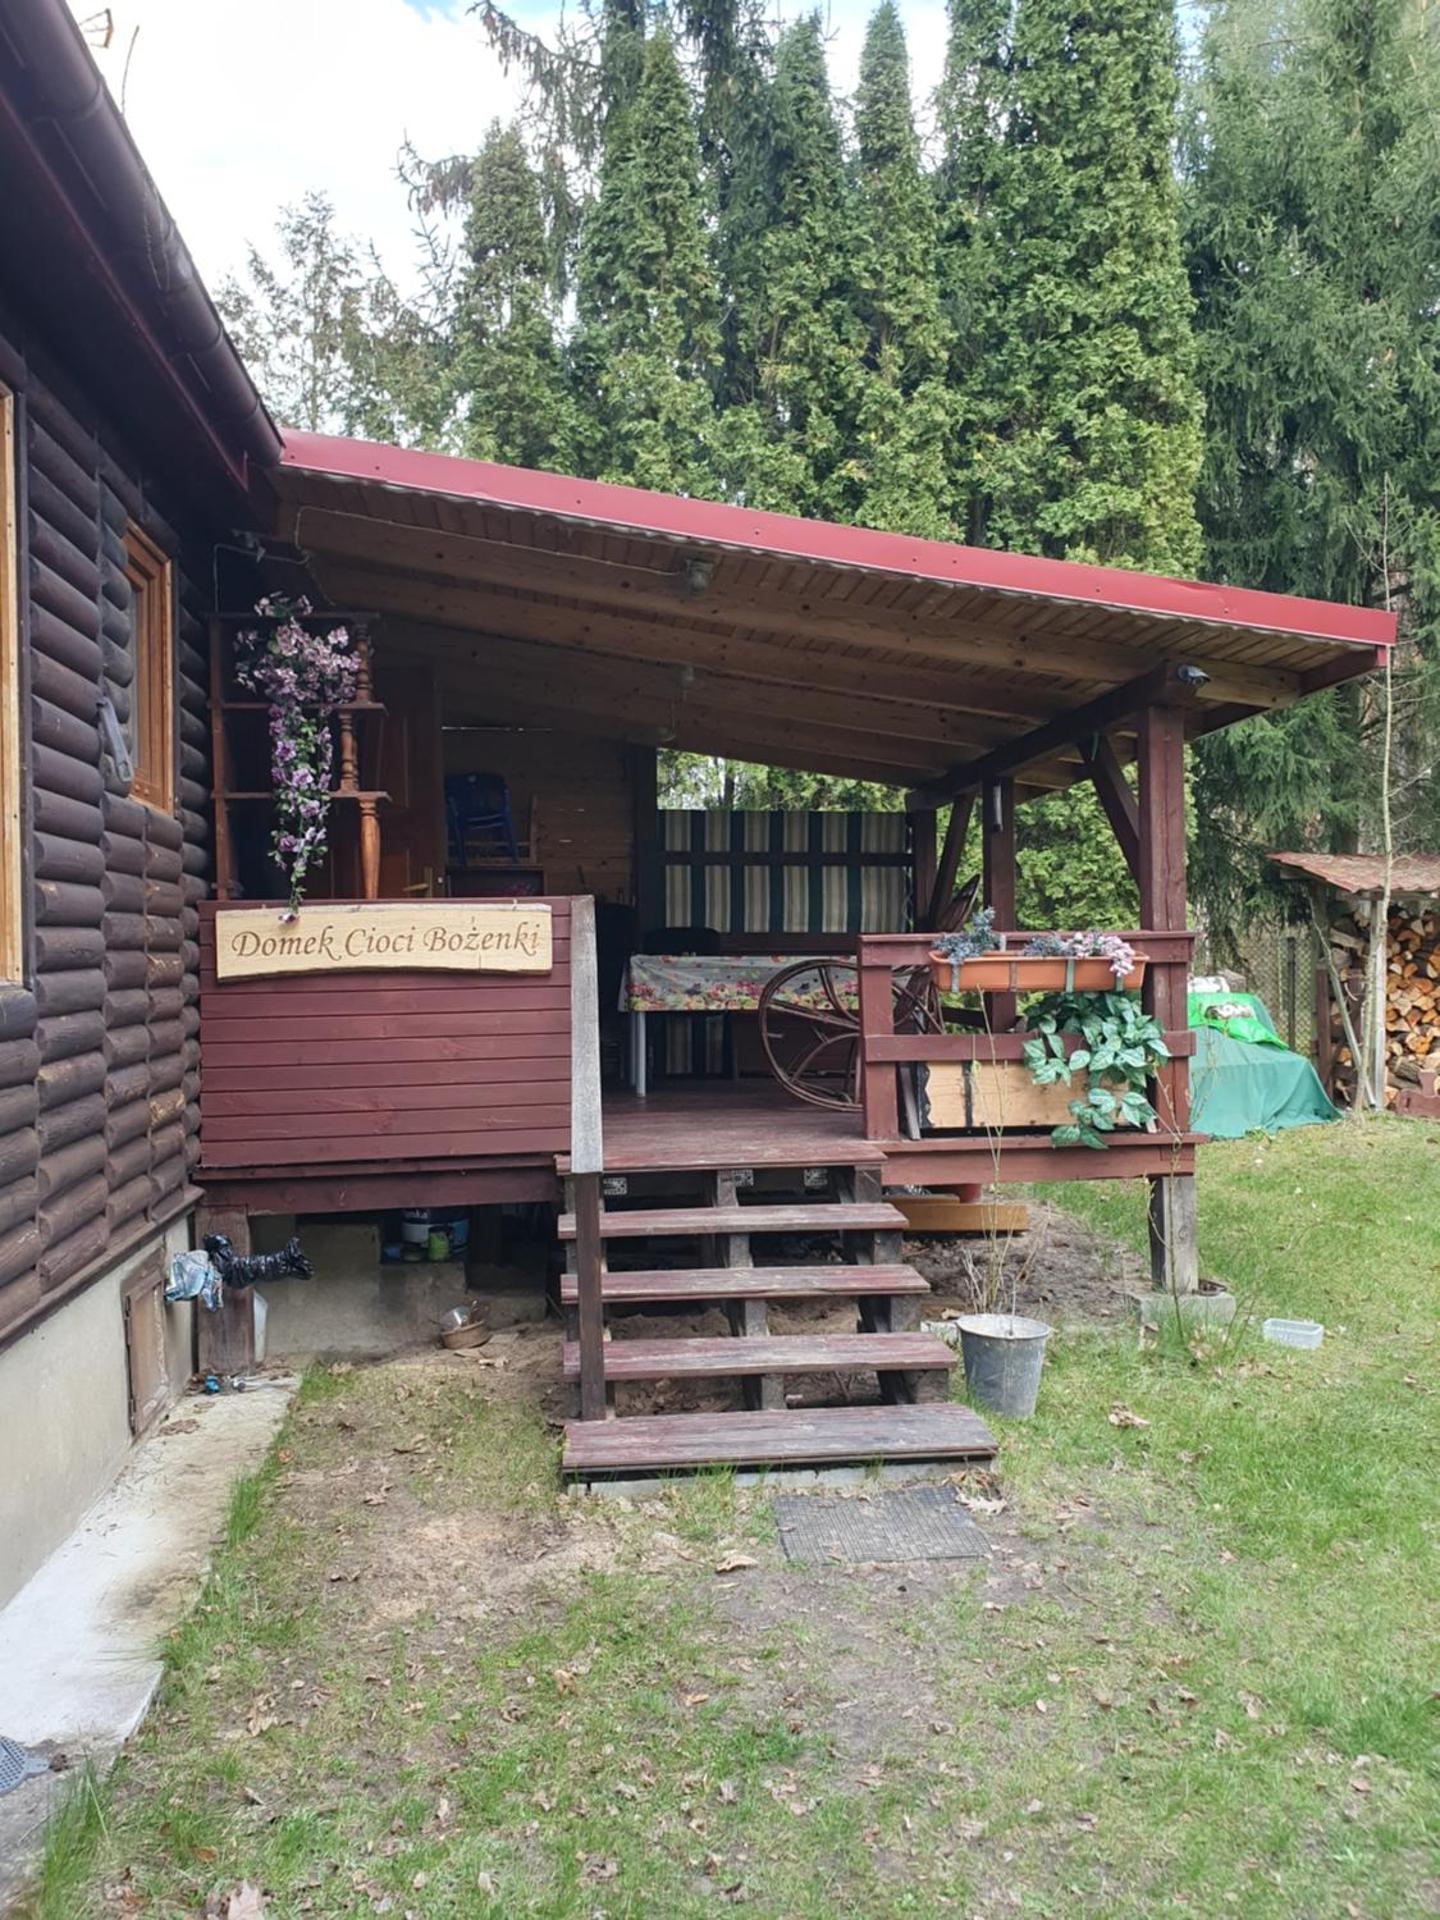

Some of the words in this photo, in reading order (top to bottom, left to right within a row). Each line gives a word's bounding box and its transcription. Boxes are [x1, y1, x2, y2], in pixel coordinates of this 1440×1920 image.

[232, 925, 342, 961] Domek
[344, 926, 416, 957] Cioci
[423, 922, 541, 956] Bożenki
